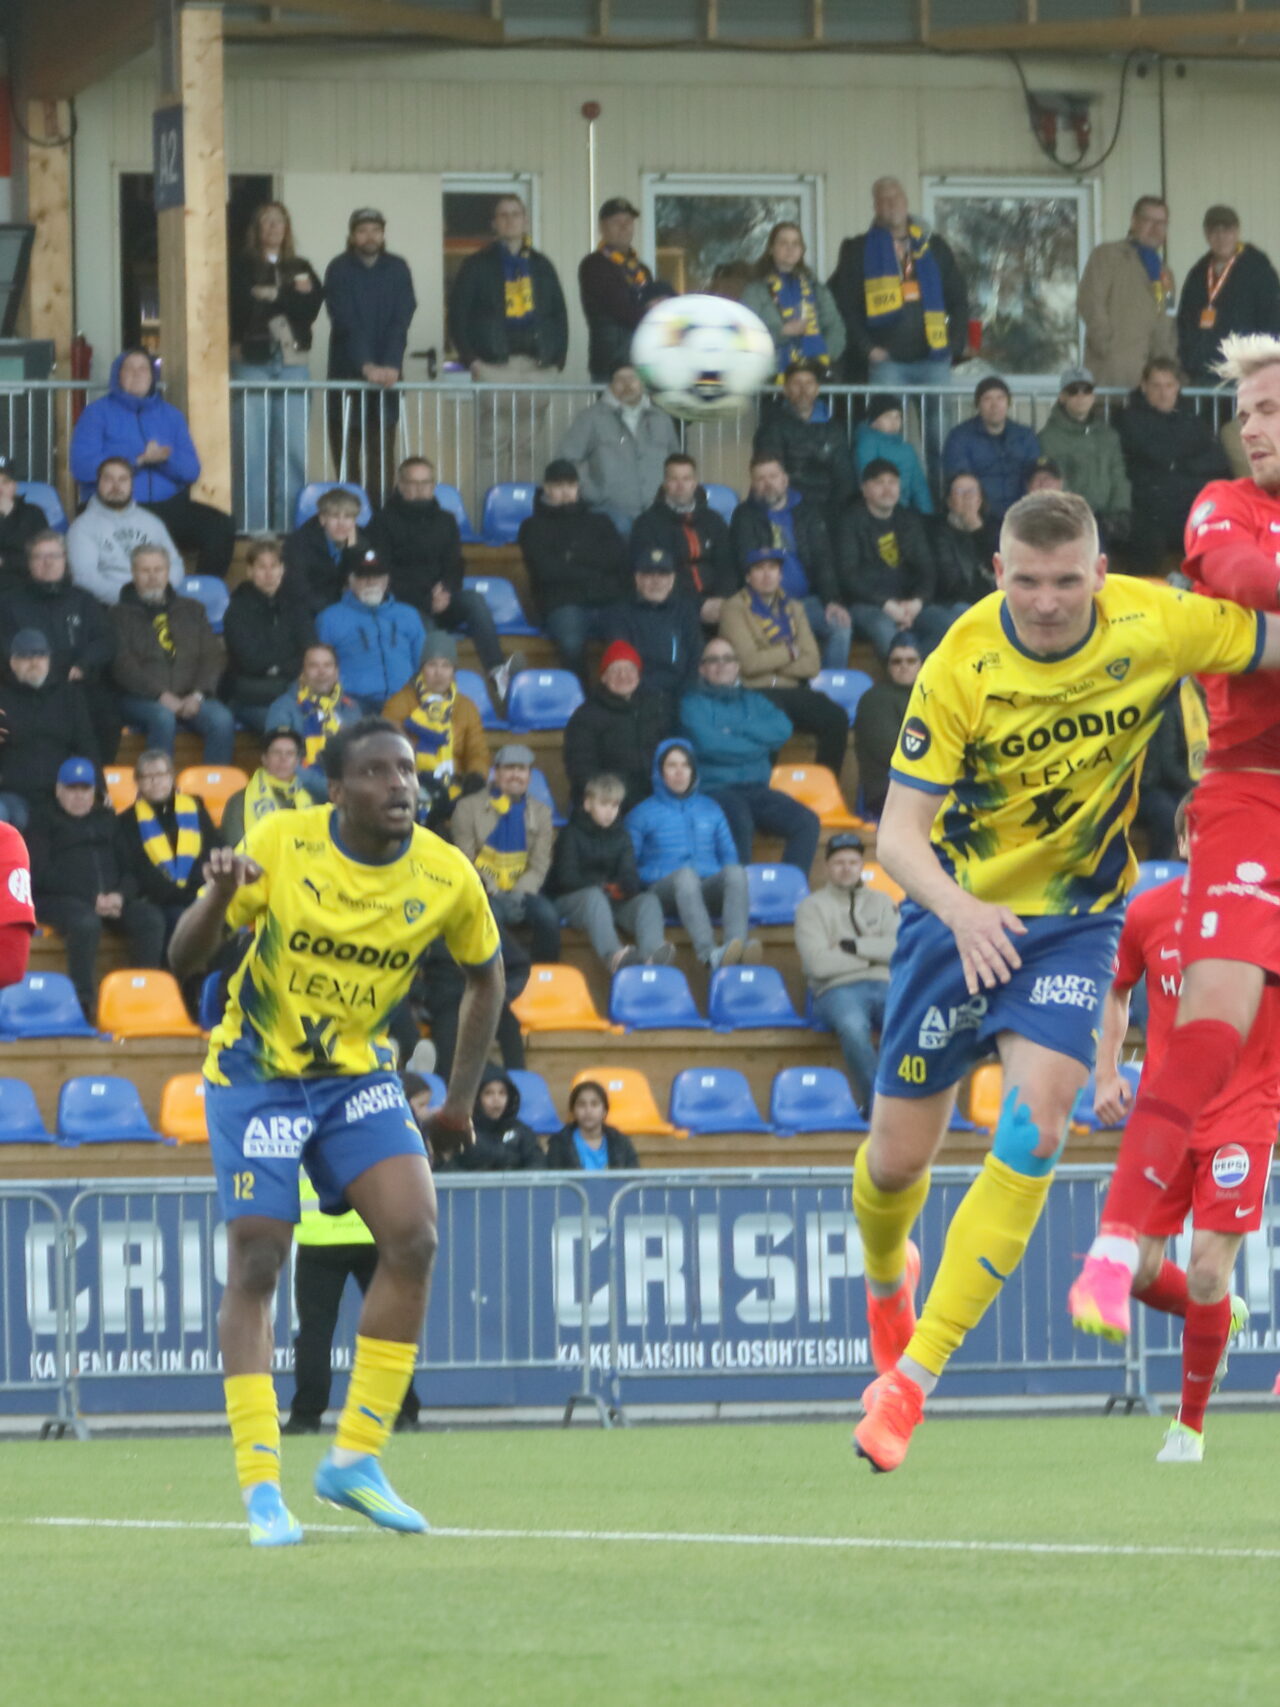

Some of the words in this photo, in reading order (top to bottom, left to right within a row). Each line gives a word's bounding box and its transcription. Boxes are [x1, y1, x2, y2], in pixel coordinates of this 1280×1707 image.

[1001, 706, 1141, 758] GOODIO
[1200, 911, 1218, 939] 9
[288, 930, 410, 970] GOODIO
[288, 970, 376, 1009] LEXIA
[1029, 987, 1099, 1011] SPORT
[898, 1055, 926, 1084] 40
[244, 1116, 313, 1142] ARO
[233, 1171, 255, 1200] 12
[552, 1212, 866, 1327] CRISP
[557, 1342, 704, 1371] KAKENLAISIIN
[711, 1338, 868, 1367] OLOSUHTEISIIN
